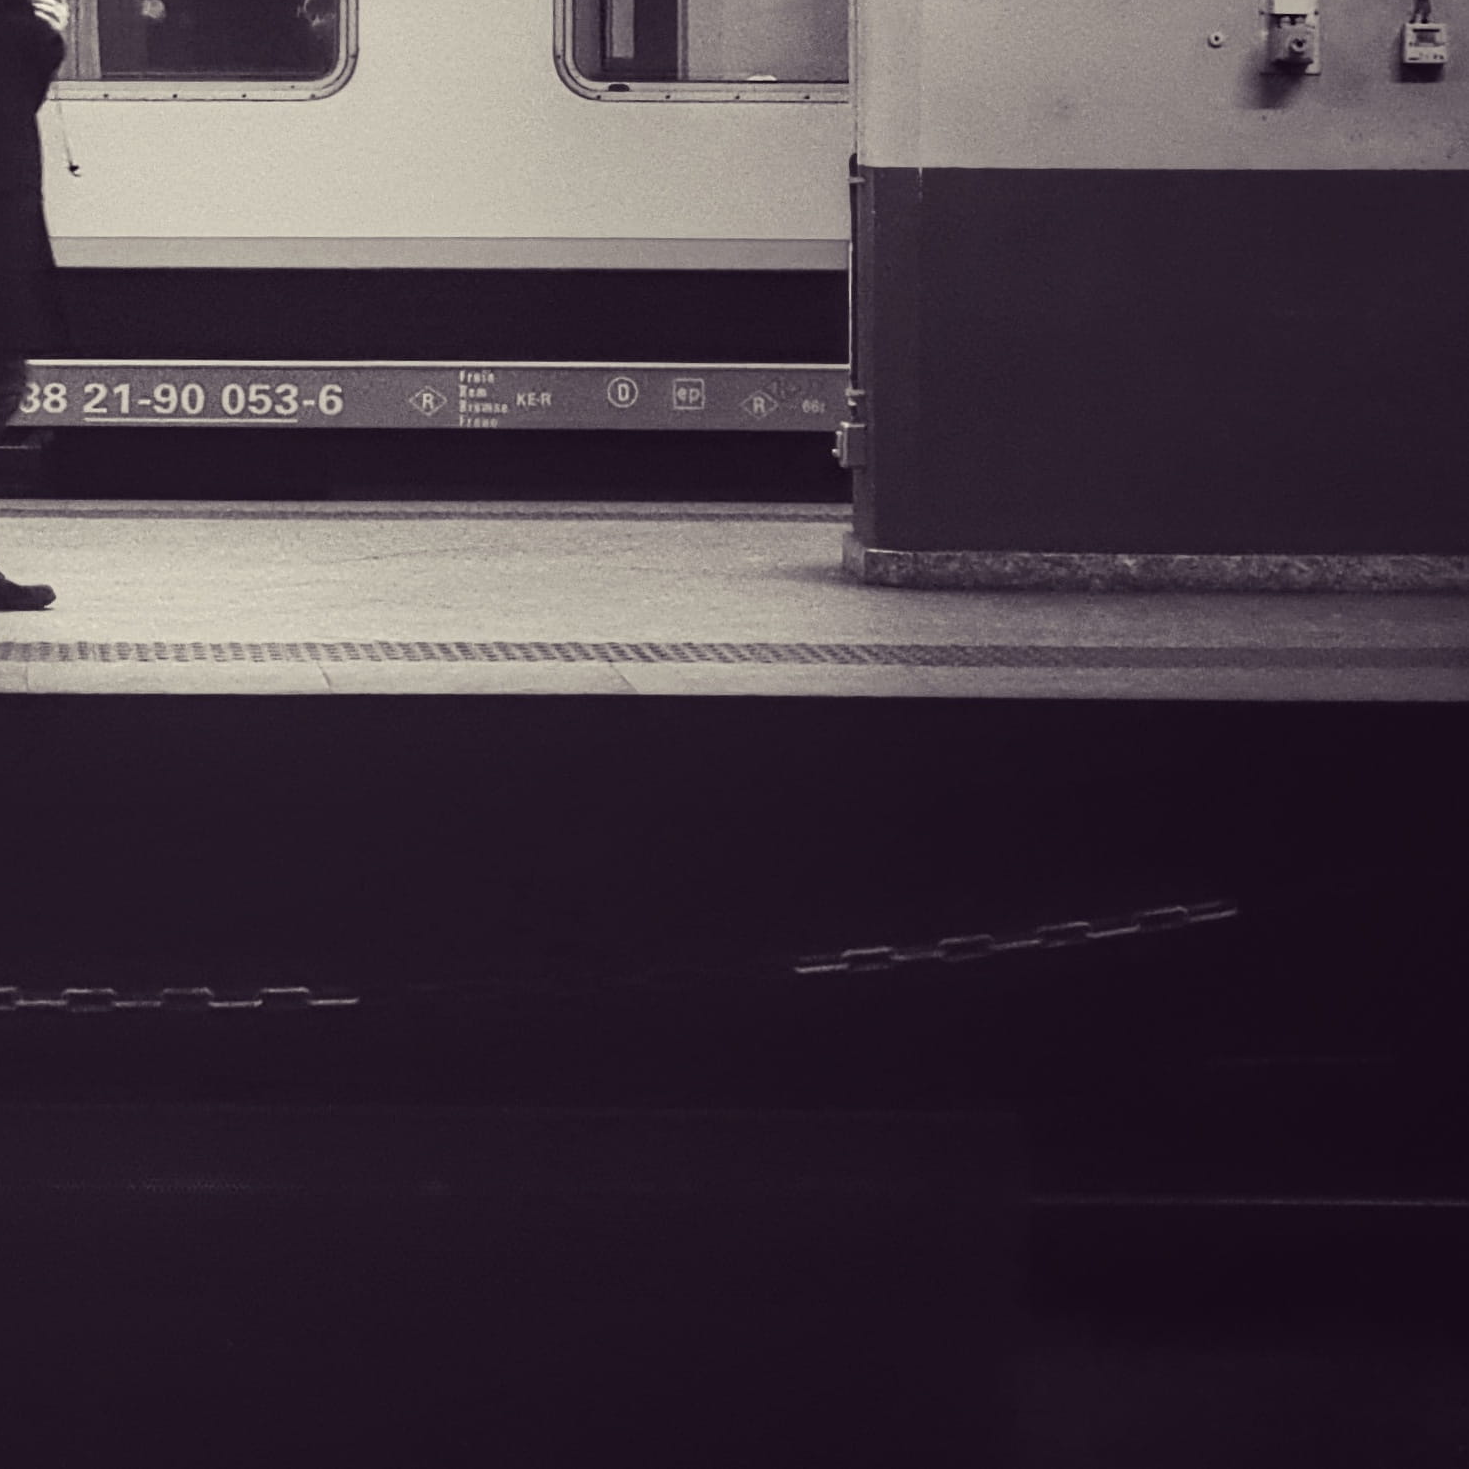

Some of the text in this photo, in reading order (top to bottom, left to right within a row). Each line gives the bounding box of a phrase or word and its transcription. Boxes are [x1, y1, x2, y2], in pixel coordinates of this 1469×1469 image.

[83, 383, 205, 414] 21-90
[221, 383, 344, 415] 053-6
[422, 392, 434, 409] R
